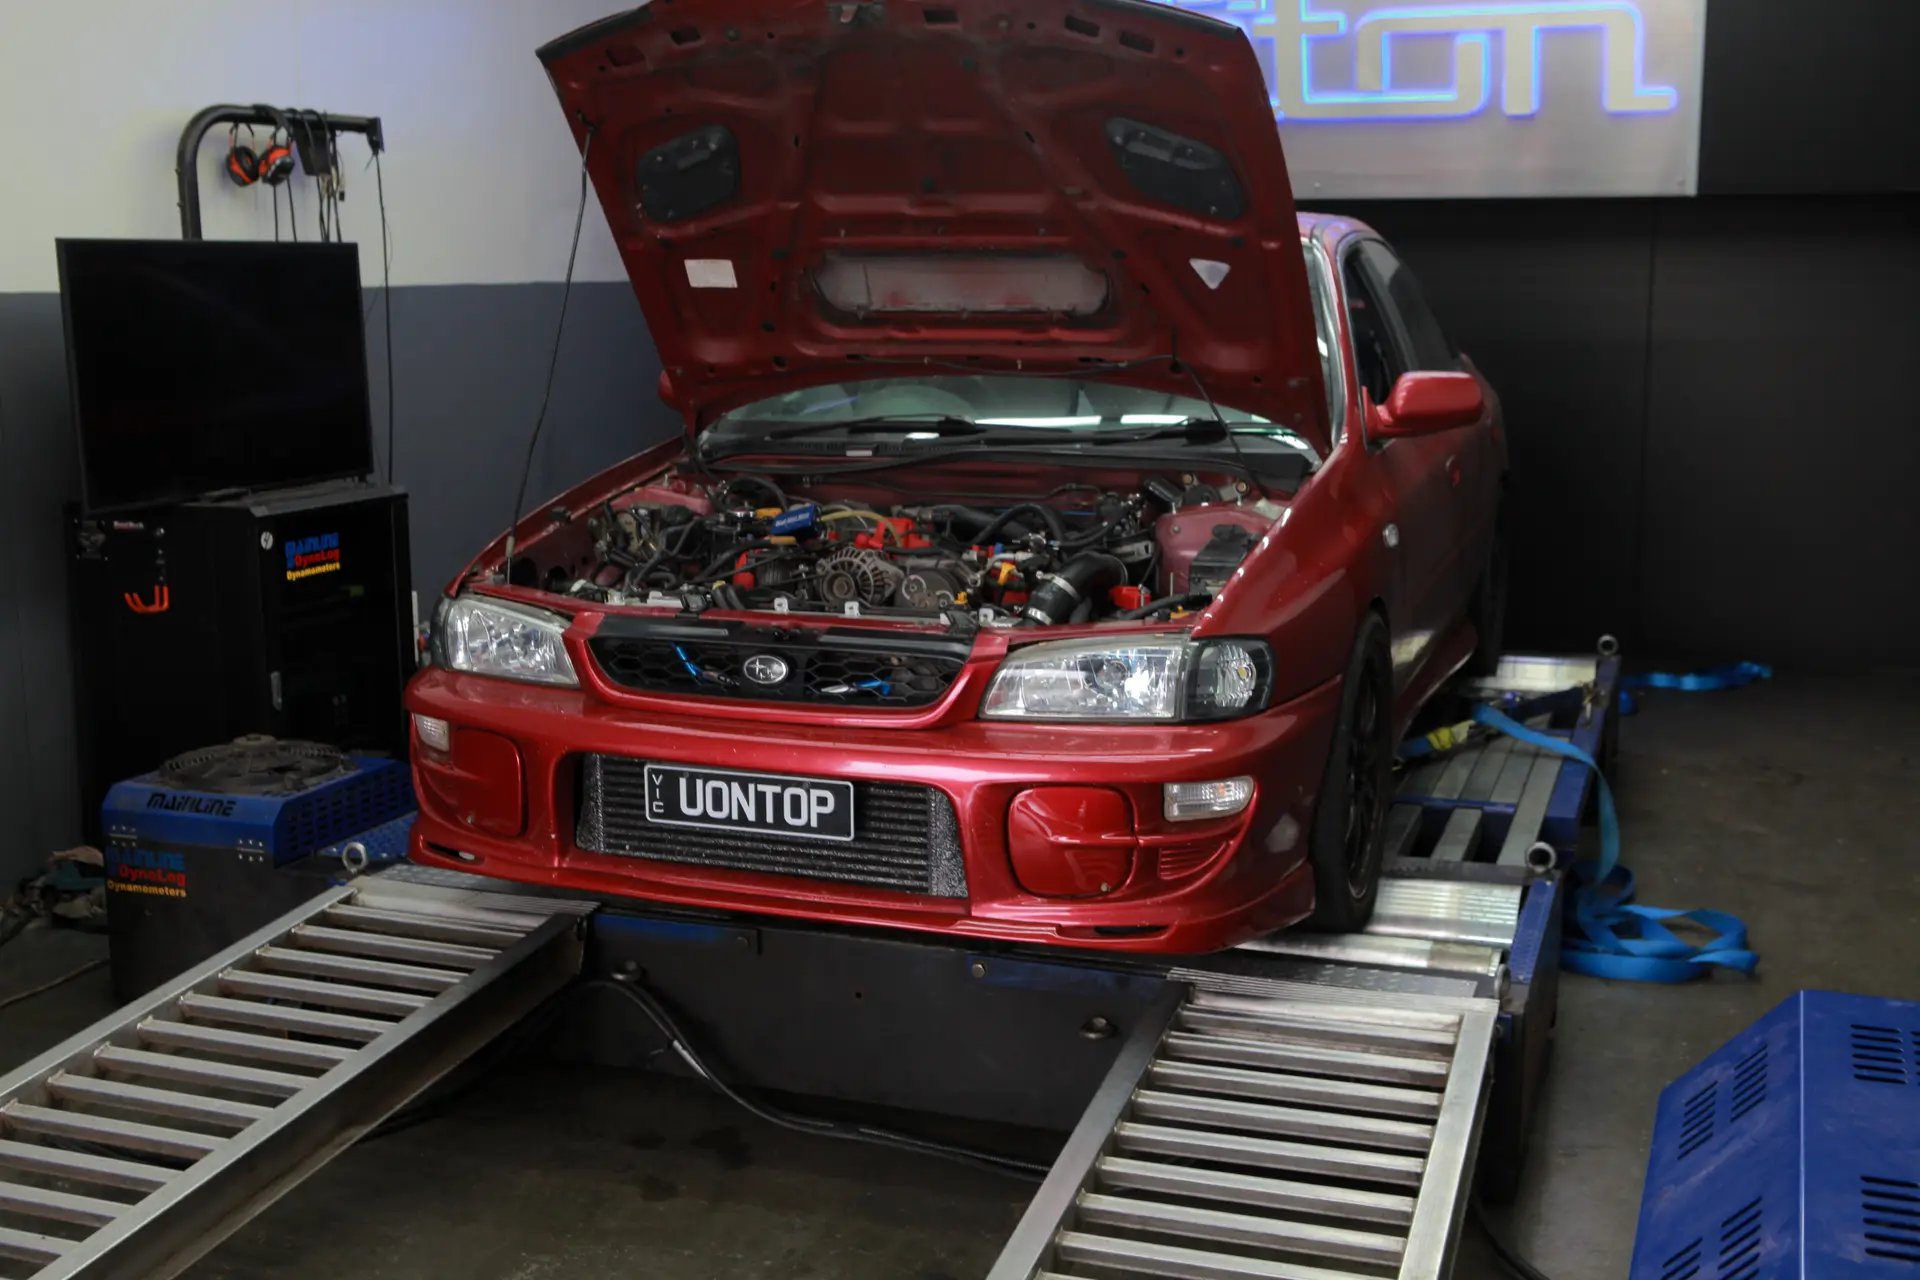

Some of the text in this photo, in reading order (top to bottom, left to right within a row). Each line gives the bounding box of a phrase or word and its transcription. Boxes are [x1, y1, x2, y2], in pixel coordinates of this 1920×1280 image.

[286, 561, 341, 581] Dynamometers
[652, 773, 665, 814] VIC
[679, 776, 835, 828] UONTOP
[107, 879, 187, 898] Dynamometers
